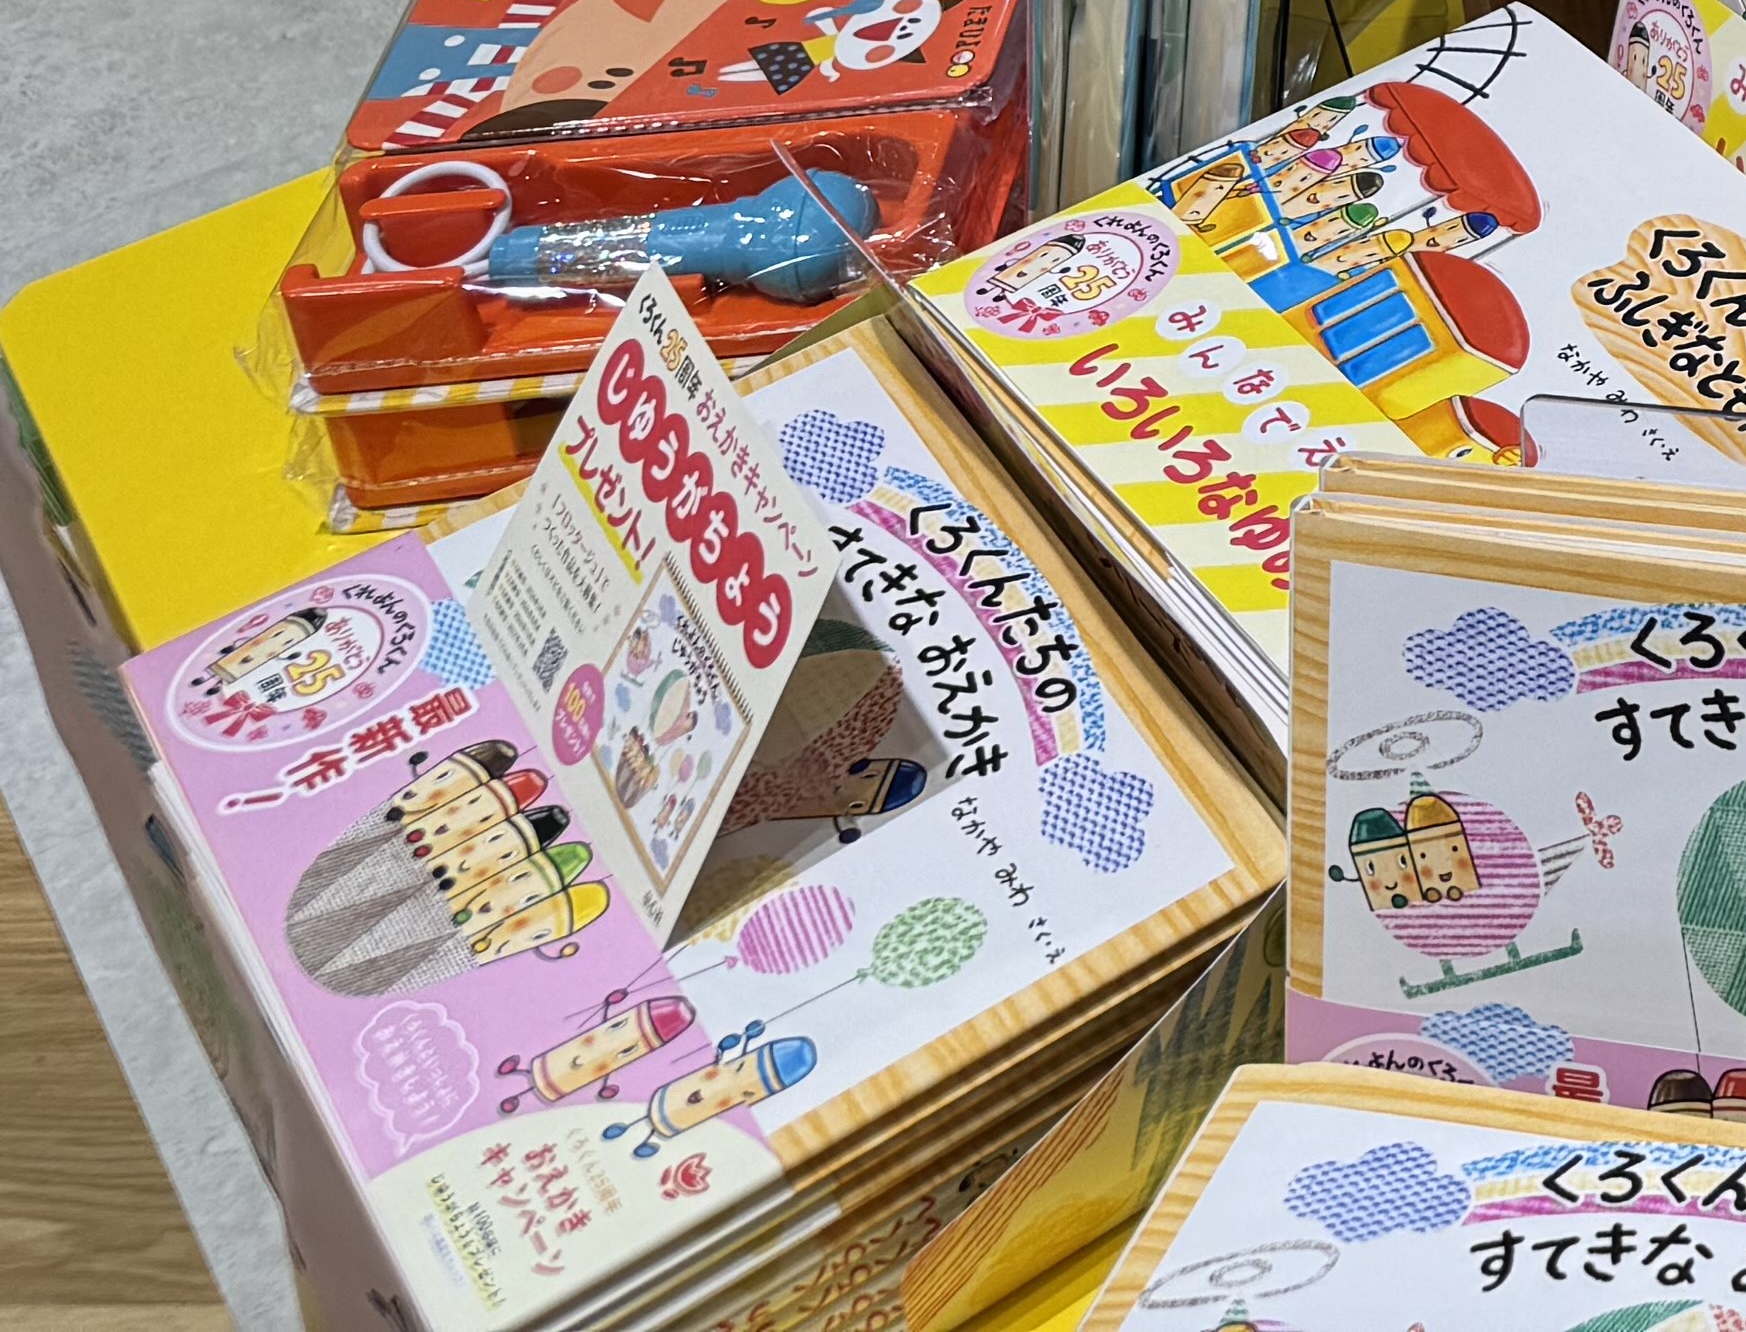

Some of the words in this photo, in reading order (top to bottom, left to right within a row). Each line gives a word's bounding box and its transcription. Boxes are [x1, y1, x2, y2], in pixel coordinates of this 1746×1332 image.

[961, 4, 994, 49] たまひよ
[566, 415, 657, 573] プレゼント!
[600, 347, 786, 655] じゆうがちょう
[637, 292, 705, 403] くろくん25周年
[696, 388, 819, 579] おえかきキャンペーン
[909, 502, 1082, 717] くろくんたちの
[228, 689, 477, 815] 最新作!
[912, 635, 1013, 781] おえかき
[479, 1143, 566, 1275] キャンペーン
[524, 1143, 593, 1239] おえかき
[1470, 1224, 1697, 1293] すてきな
